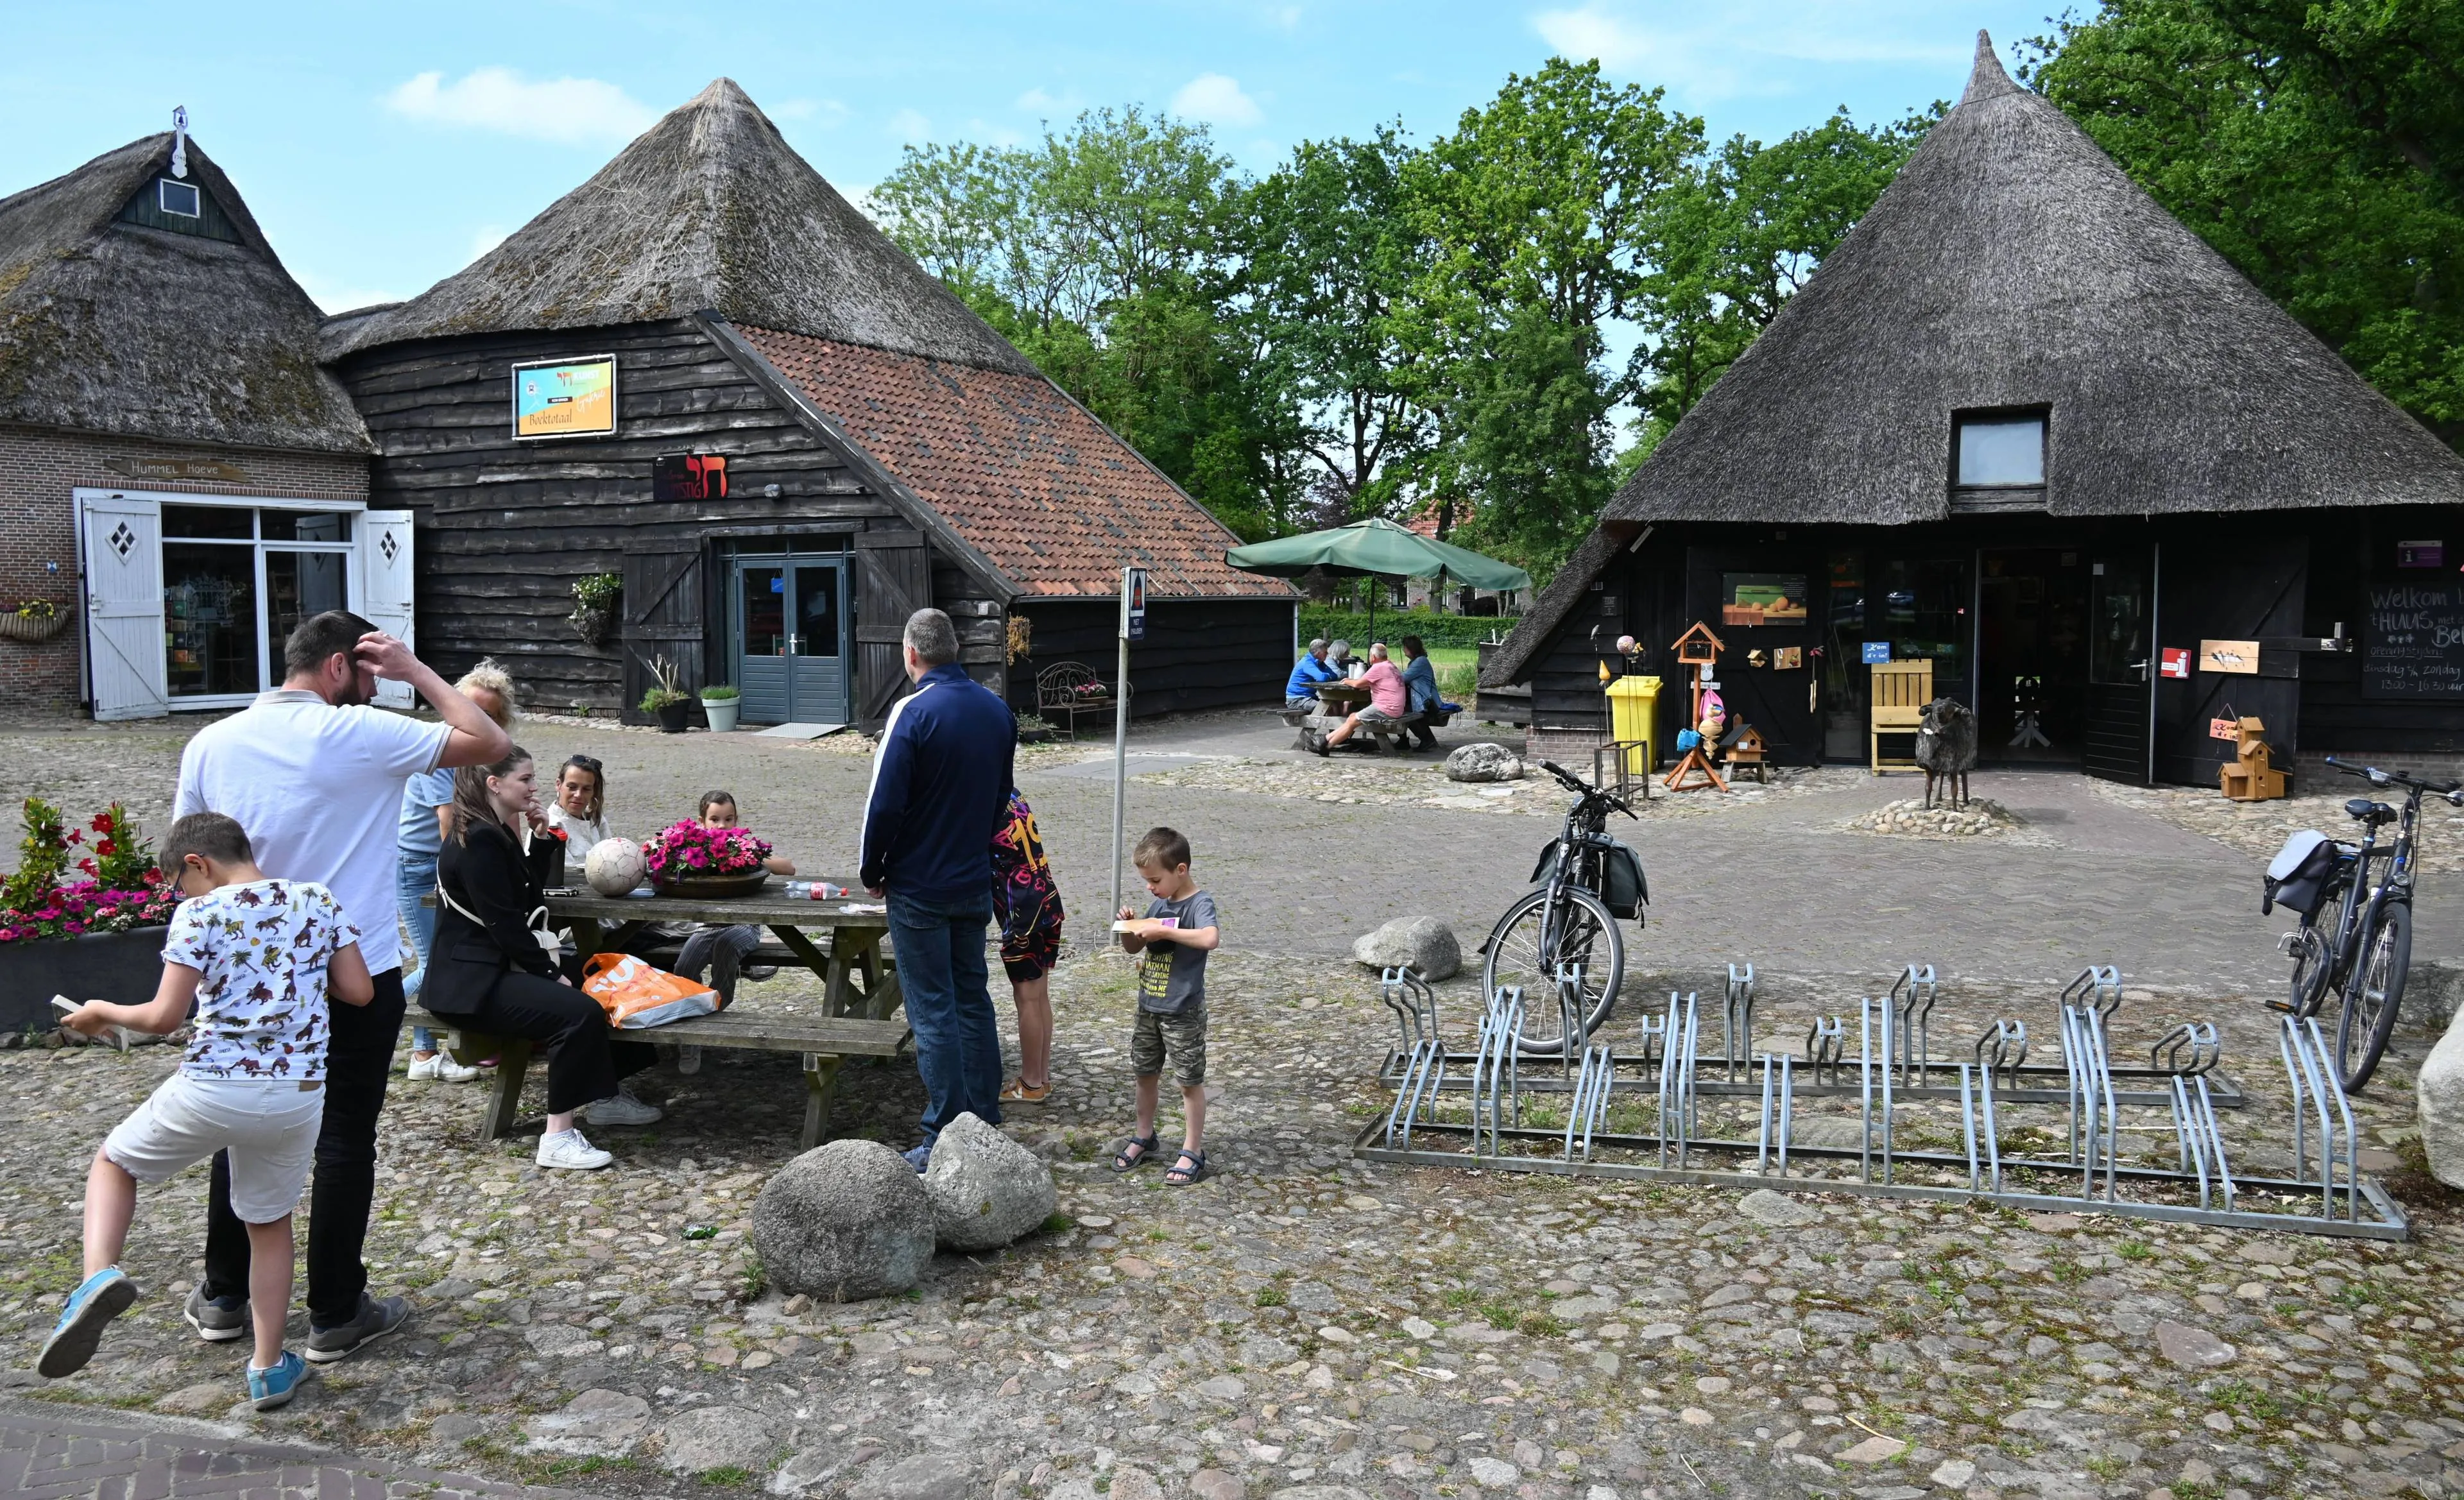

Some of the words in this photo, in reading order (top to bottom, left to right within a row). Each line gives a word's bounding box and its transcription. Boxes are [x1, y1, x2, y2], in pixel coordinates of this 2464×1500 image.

[574, 370, 600, 380] KUNST
[529, 408, 572, 426] Boektotaal
[132, 461, 179, 474] HUMMEL
[187, 463, 218, 474] Hoeve
[2370, 586, 2449, 609] Welkom
[2363, 662, 2405, 679] dinsdag
[2423, 661, 2461, 681] zondag
